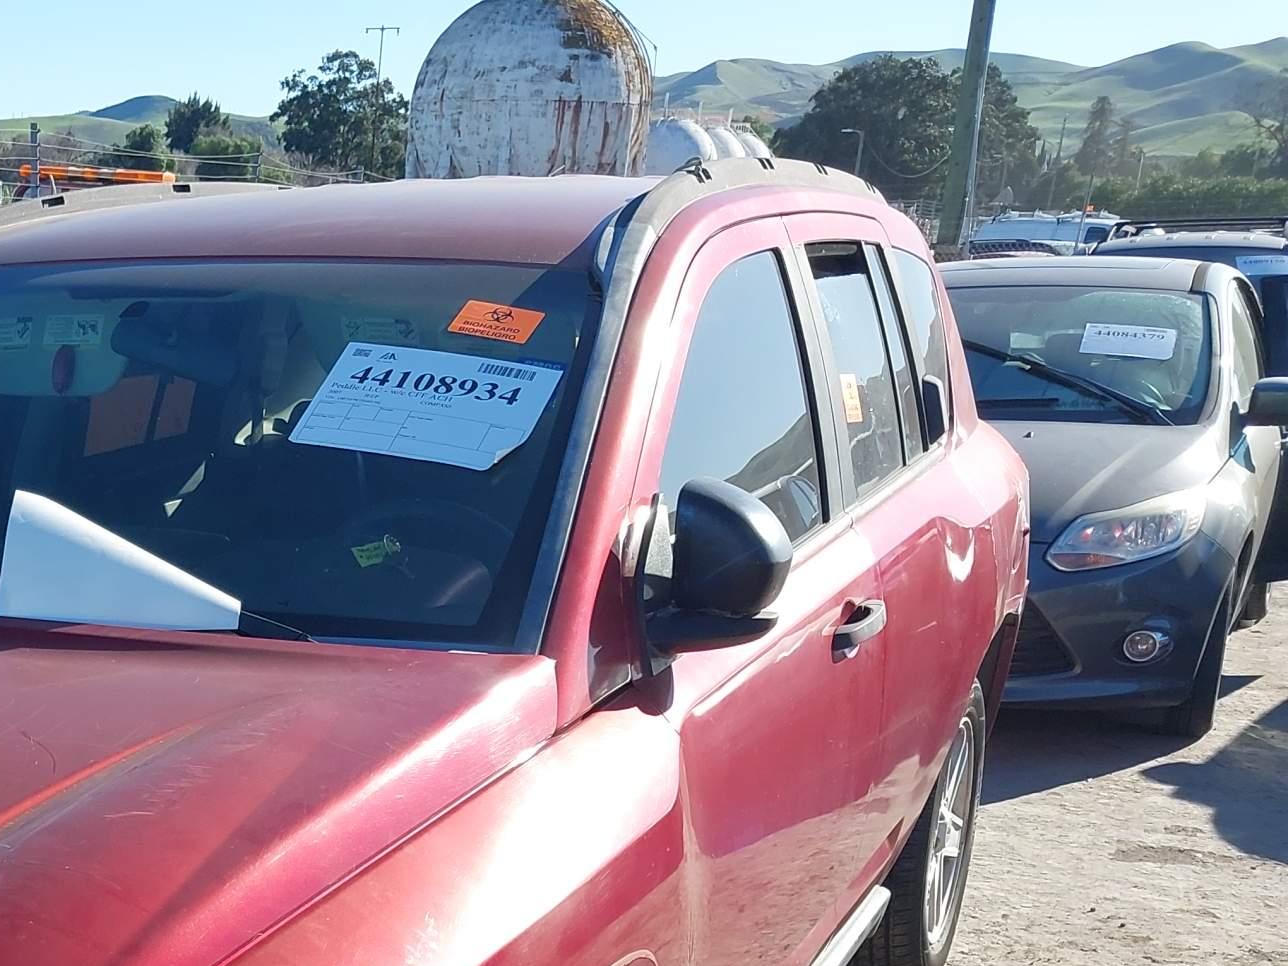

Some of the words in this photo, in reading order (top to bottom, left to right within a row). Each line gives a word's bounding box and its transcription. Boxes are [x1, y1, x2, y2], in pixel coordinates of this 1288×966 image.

[458, 326, 516, 340] BIOPELIGRO
[462, 320, 520, 334] BIOHAZARD
[350, 366, 522, 406] 44108934
